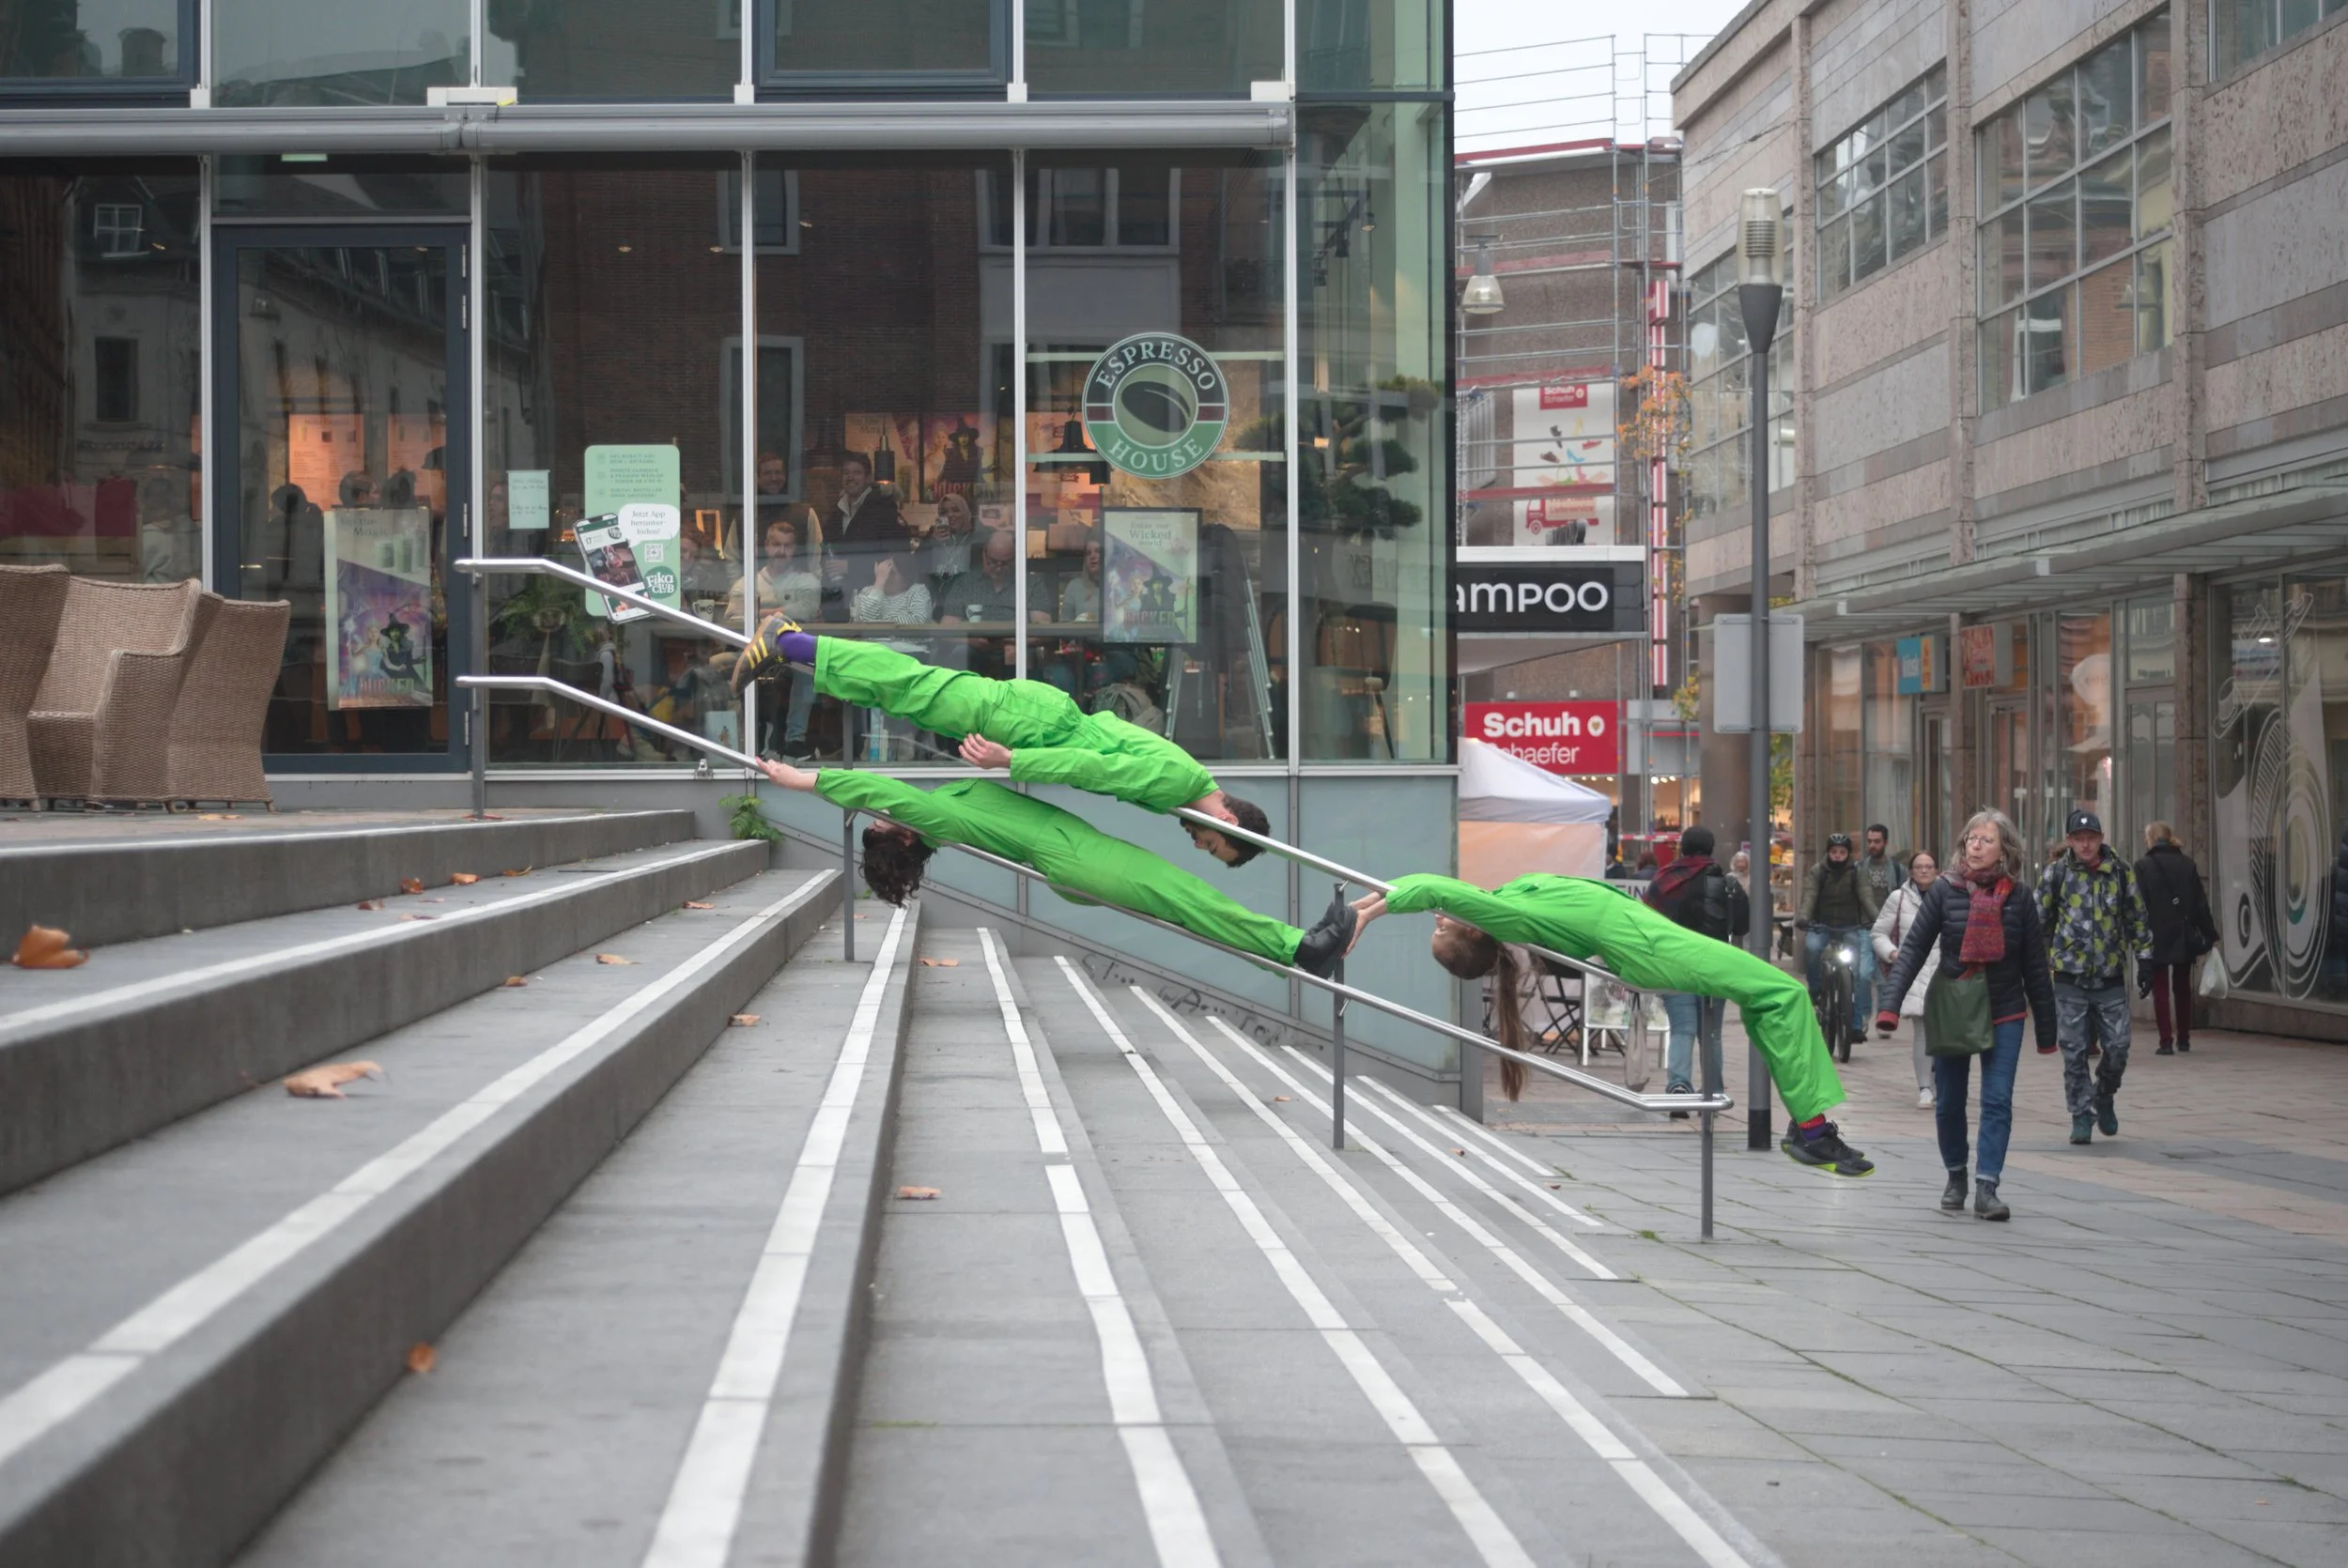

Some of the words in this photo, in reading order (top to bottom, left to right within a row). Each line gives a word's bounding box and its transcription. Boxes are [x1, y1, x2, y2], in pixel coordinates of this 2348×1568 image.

[1095, 341, 1216, 391] ESPRESSO
[1107, 438, 1204, 472] HOUSE
[631, 510, 649, 518] Jetzt
[651, 510, 666, 519] App
[1129, 529, 1172, 540] Wicked
[651, 584, 675, 594] CLUB
[1483, 712, 1581, 738] Schuh
[1487, 742, 1581, 764] haefer
